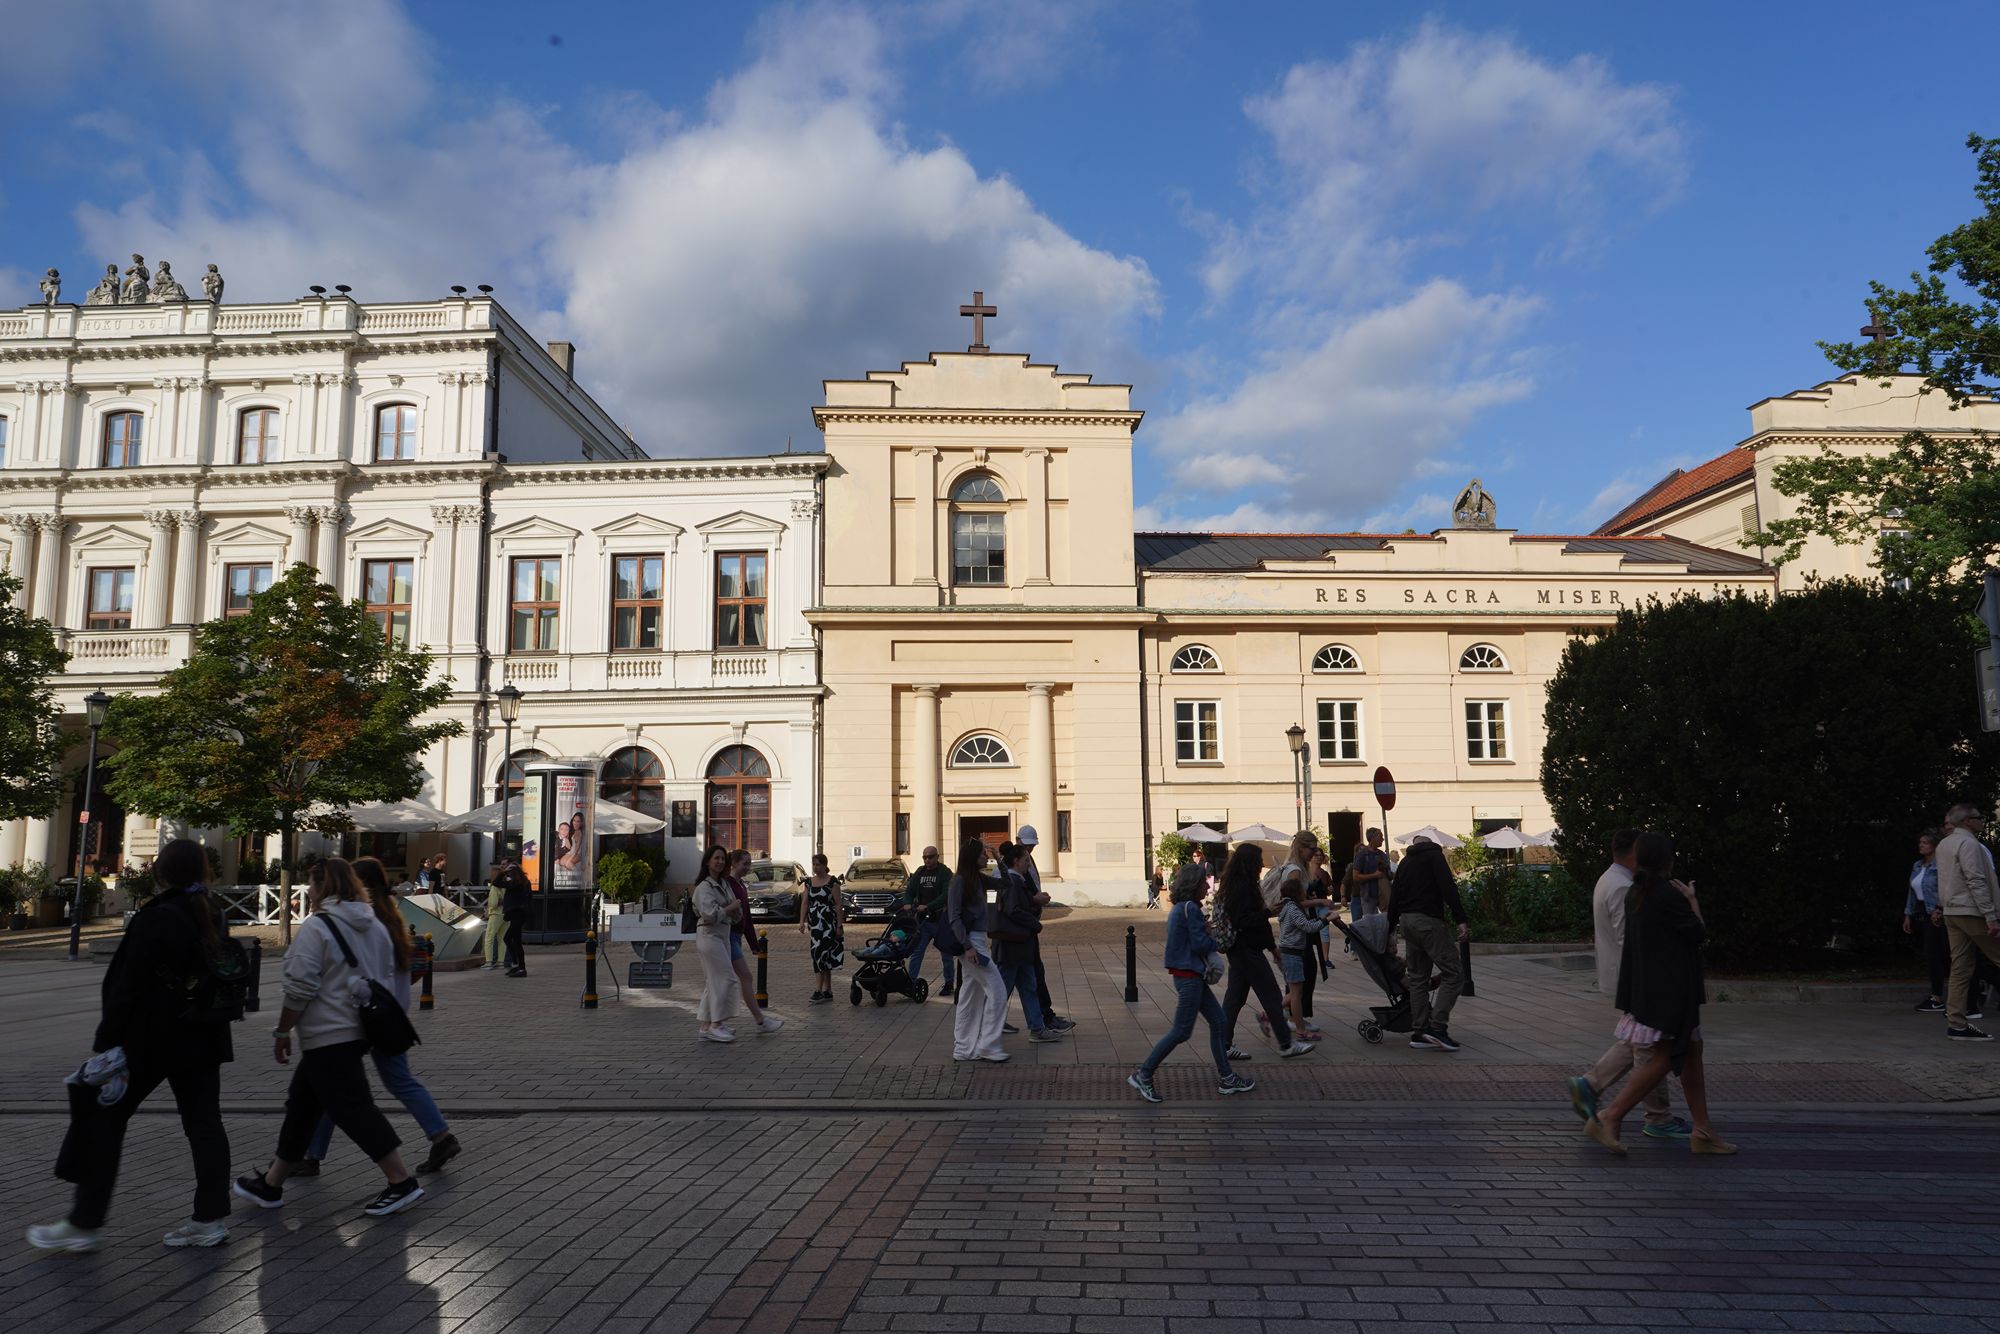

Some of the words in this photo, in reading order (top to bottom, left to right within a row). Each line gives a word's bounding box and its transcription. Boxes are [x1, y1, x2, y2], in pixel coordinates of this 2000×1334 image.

[83, 319, 121, 331] ROKU
[1315, 588, 1366, 603] RES
[1404, 588, 1501, 604] SACRA
[1537, 590, 1622, 604] MISER
